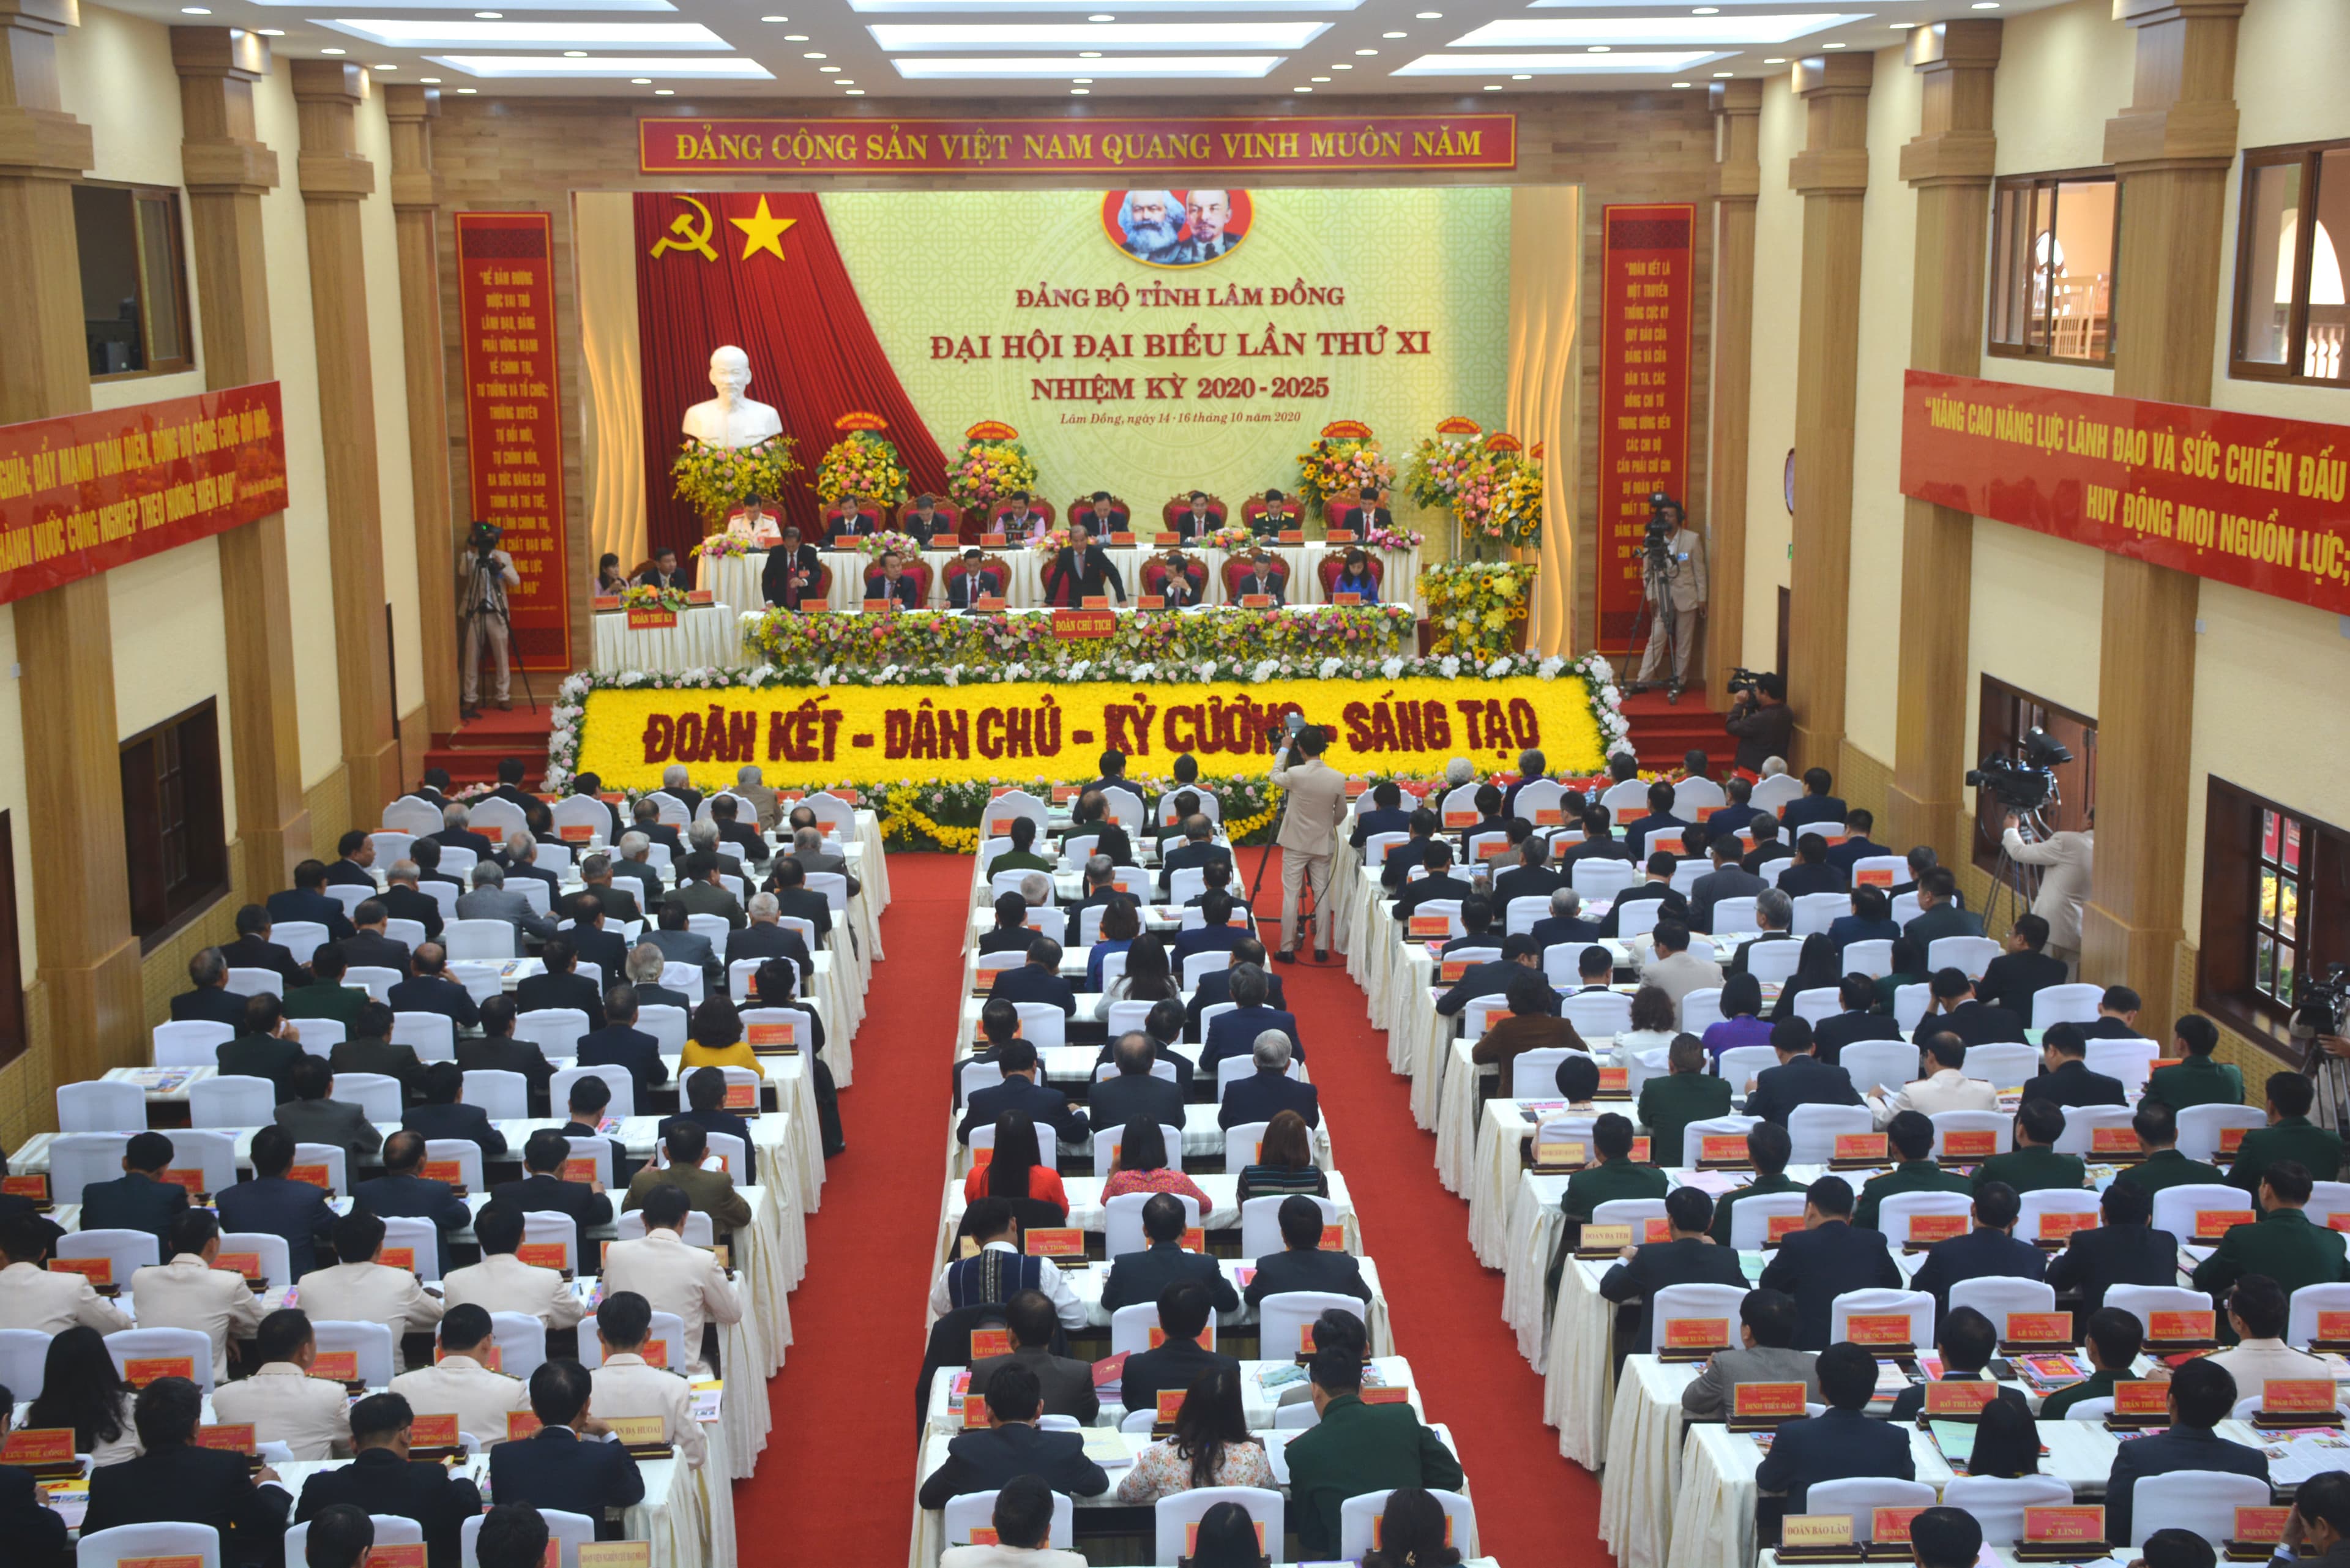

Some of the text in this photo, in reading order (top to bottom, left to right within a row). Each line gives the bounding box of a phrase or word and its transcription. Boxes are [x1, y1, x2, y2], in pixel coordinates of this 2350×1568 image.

[676, 125, 1482, 166] ĐẢNG CỘNG SẢN VIỆT NAM QUANG VINH MUÔN NĂM
[1016, 277, 1345, 312] ĐẢNG BỘ TỈNH LÂM ĐỒNG
[930, 322, 1431, 364] ĐẠI HỘI ĐẠI BIỂU LẦN THỨ XI
[1031, 373, 1135, 404] NHIỆM
[1145, 372, 1188, 399] KỲ
[1061, 414, 1086, 424] Lâm
[1091, 412, 1124, 425] Đồng,
[1127, 414, 1155, 425] ngày
[1193, 412, 1227, 424] tháng
[1231, 413, 1242, 422] 10
[1245, 413, 1271, 422] năm
[1274, 412, 1300, 422] 2020
[1968, 403, 1993, 438] CAO
[1995, 403, 2034, 445] NĂNG
[2037, 412, 2064, 456] LỰC
[2067, 414, 2108, 460] LÃNH
[2113, 426, 2148, 472] ĐẠO
[2152, 425, 2176, 471] VÀ
[2180, 430, 2220, 480] SỨC
[2225, 437, 2293, 493] CHIẾN
[2298, 445, 2348, 503] ĐẤU
[139, 491, 165, 531] THEO
[2086, 483, 2118, 524] HUY
[2123, 487, 2173, 539] ĐỘNG
[2177, 504, 2215, 555] MỌI
[2218, 507, 2293, 567] NGUỒN
[1056, 616, 1112, 633] ĐOÀN CHỦ TỊCH
[643, 704, 756, 763] ĐOÀN
[769, 694, 843, 762] KẾT
[885, 697, 969, 760] DÂN
[977, 693, 1062, 760] CHỦ
[1347, 689, 1452, 754] SÁNG
[1458, 697, 1540, 759] TẠO
